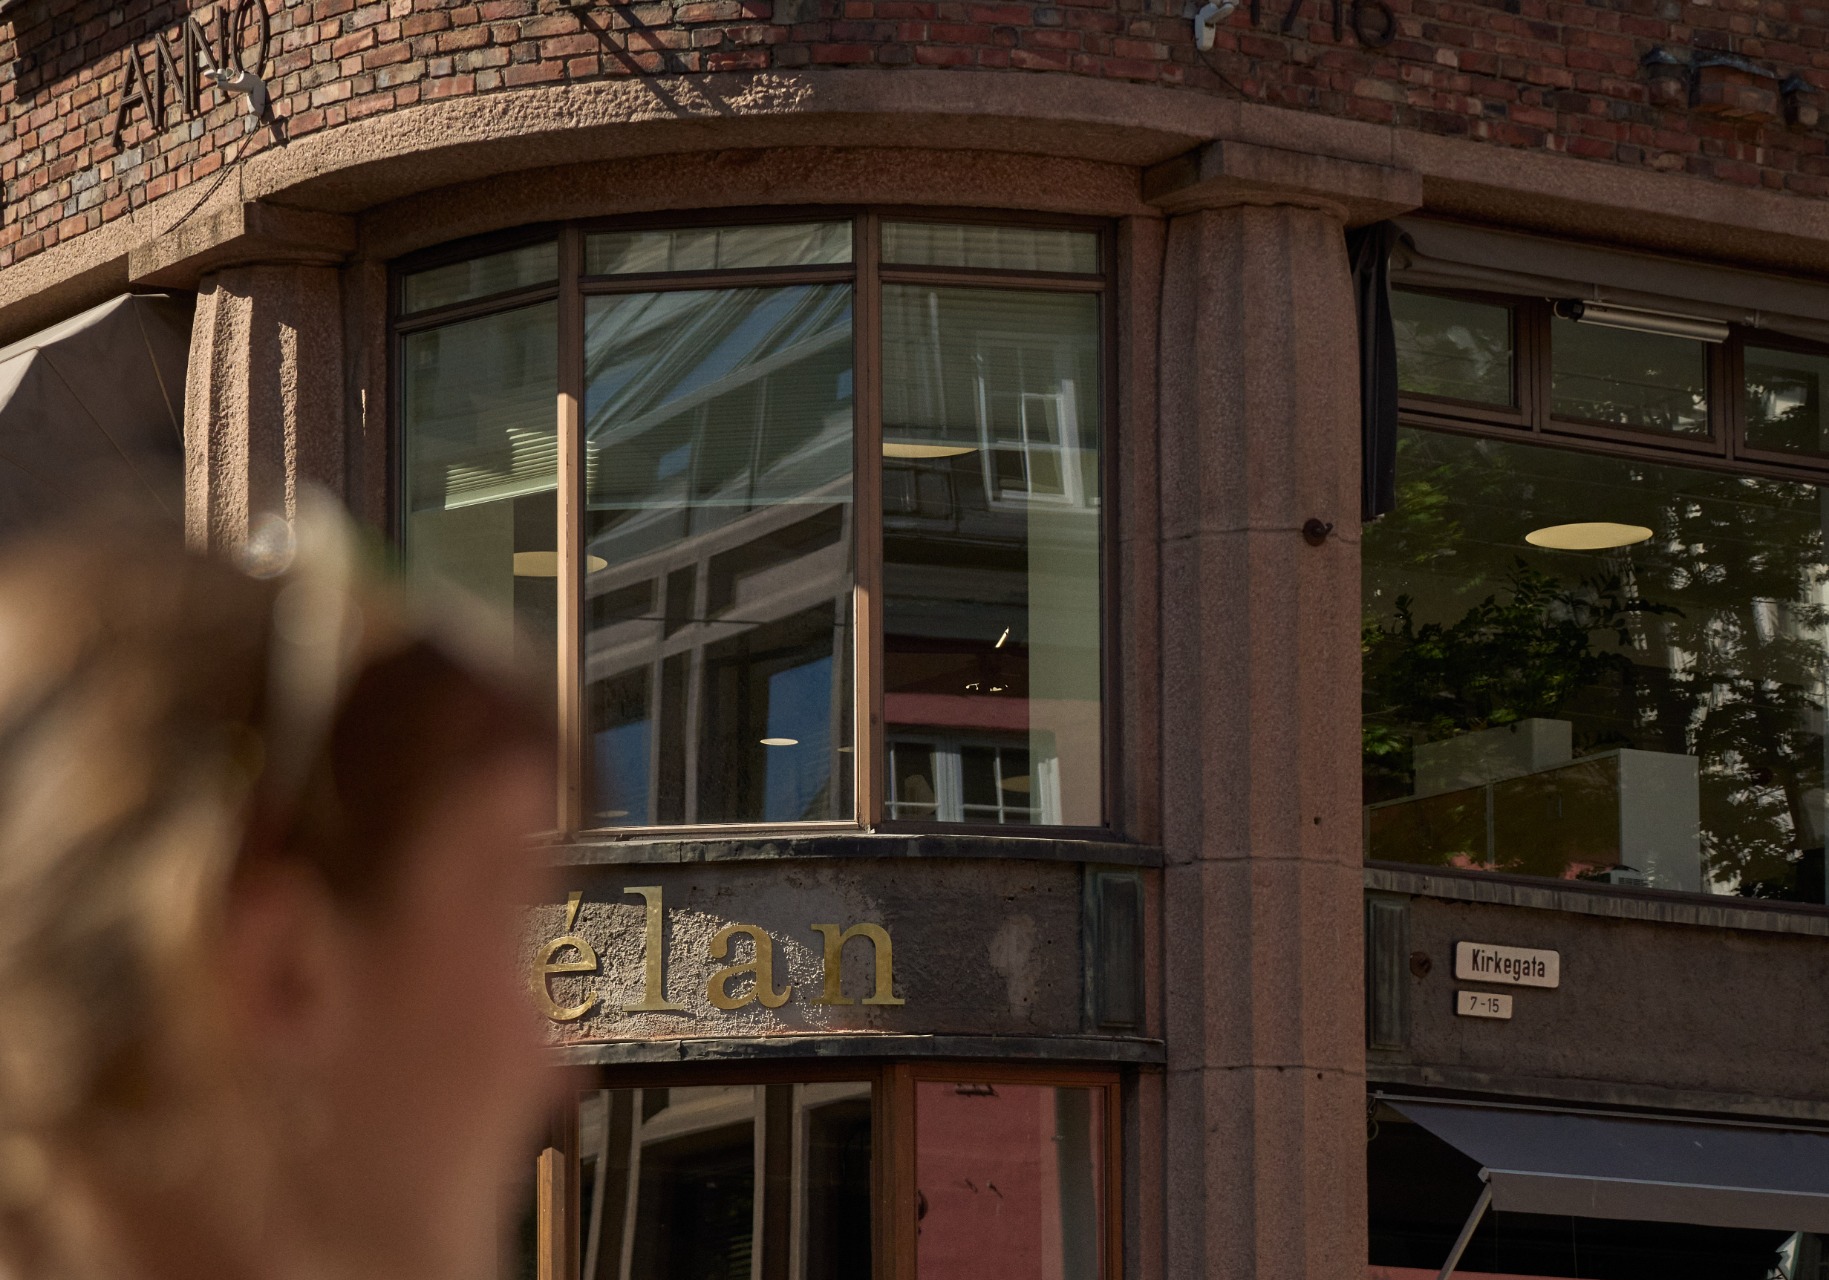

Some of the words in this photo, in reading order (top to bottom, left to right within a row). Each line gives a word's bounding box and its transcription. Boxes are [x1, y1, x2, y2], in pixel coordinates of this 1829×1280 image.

[112, 0, 270, 148] ANNO
[531, 885, 905, 1021] élan
[1471, 948, 1545, 982] Kirkegata
